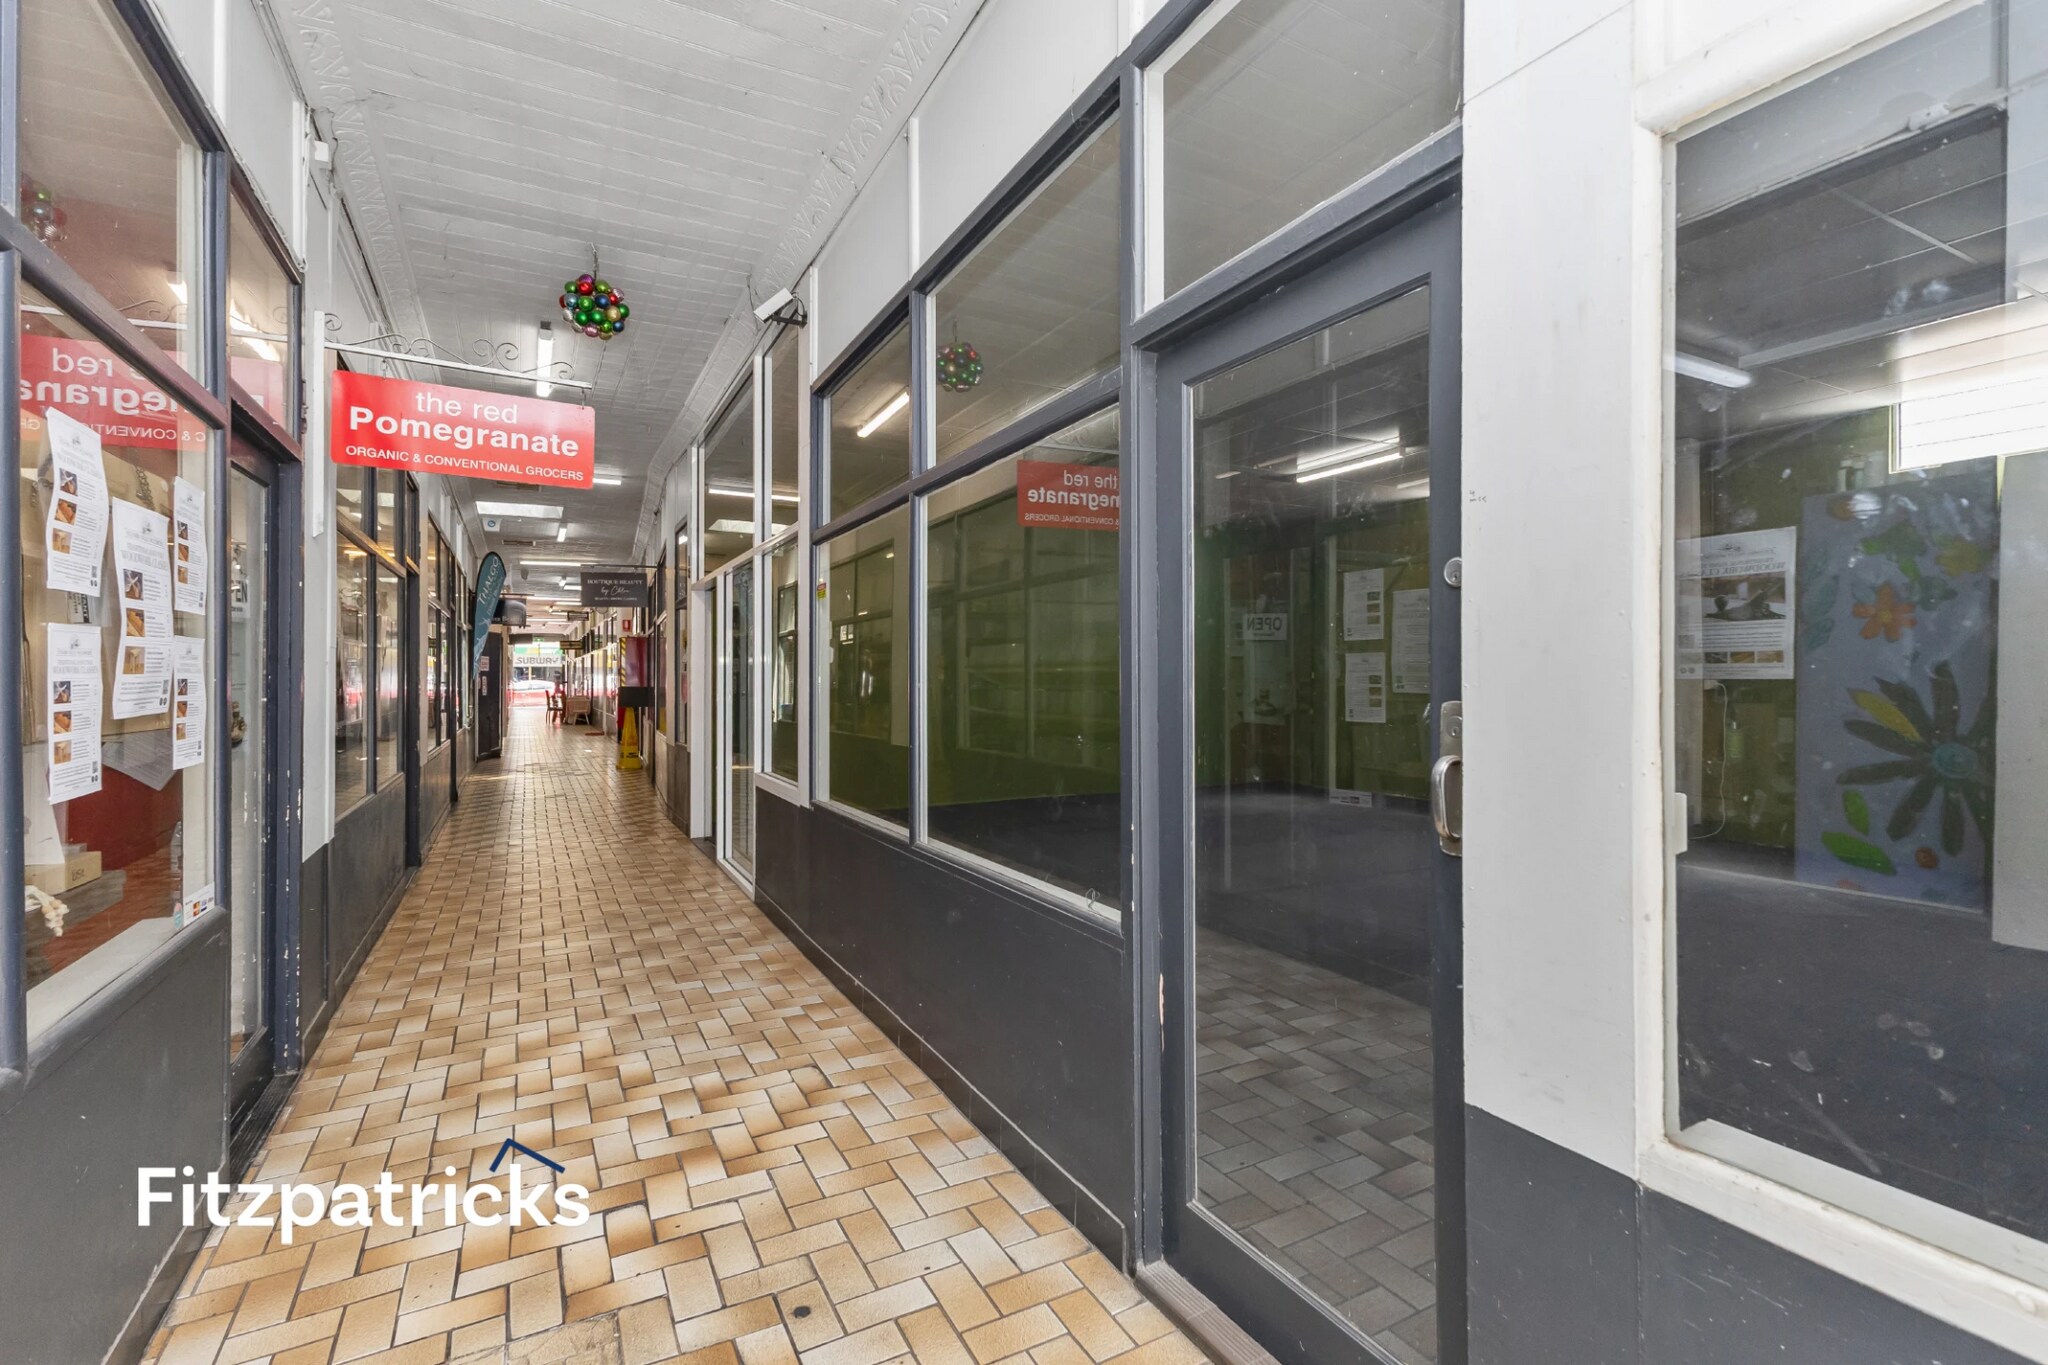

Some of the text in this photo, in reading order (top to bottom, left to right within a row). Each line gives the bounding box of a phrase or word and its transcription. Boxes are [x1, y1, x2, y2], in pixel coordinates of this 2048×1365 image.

[415, 391, 518, 424] the red
[349, 405, 580, 457] Pomegranate
[345, 445, 584, 481] ORGANIC & CONVENTIONAL GROCERS
[476, 555, 500, 606] THALGO
[587, 578, 619, 586] BOUTIQUE
[516, 656, 559, 665] SUBWAY
